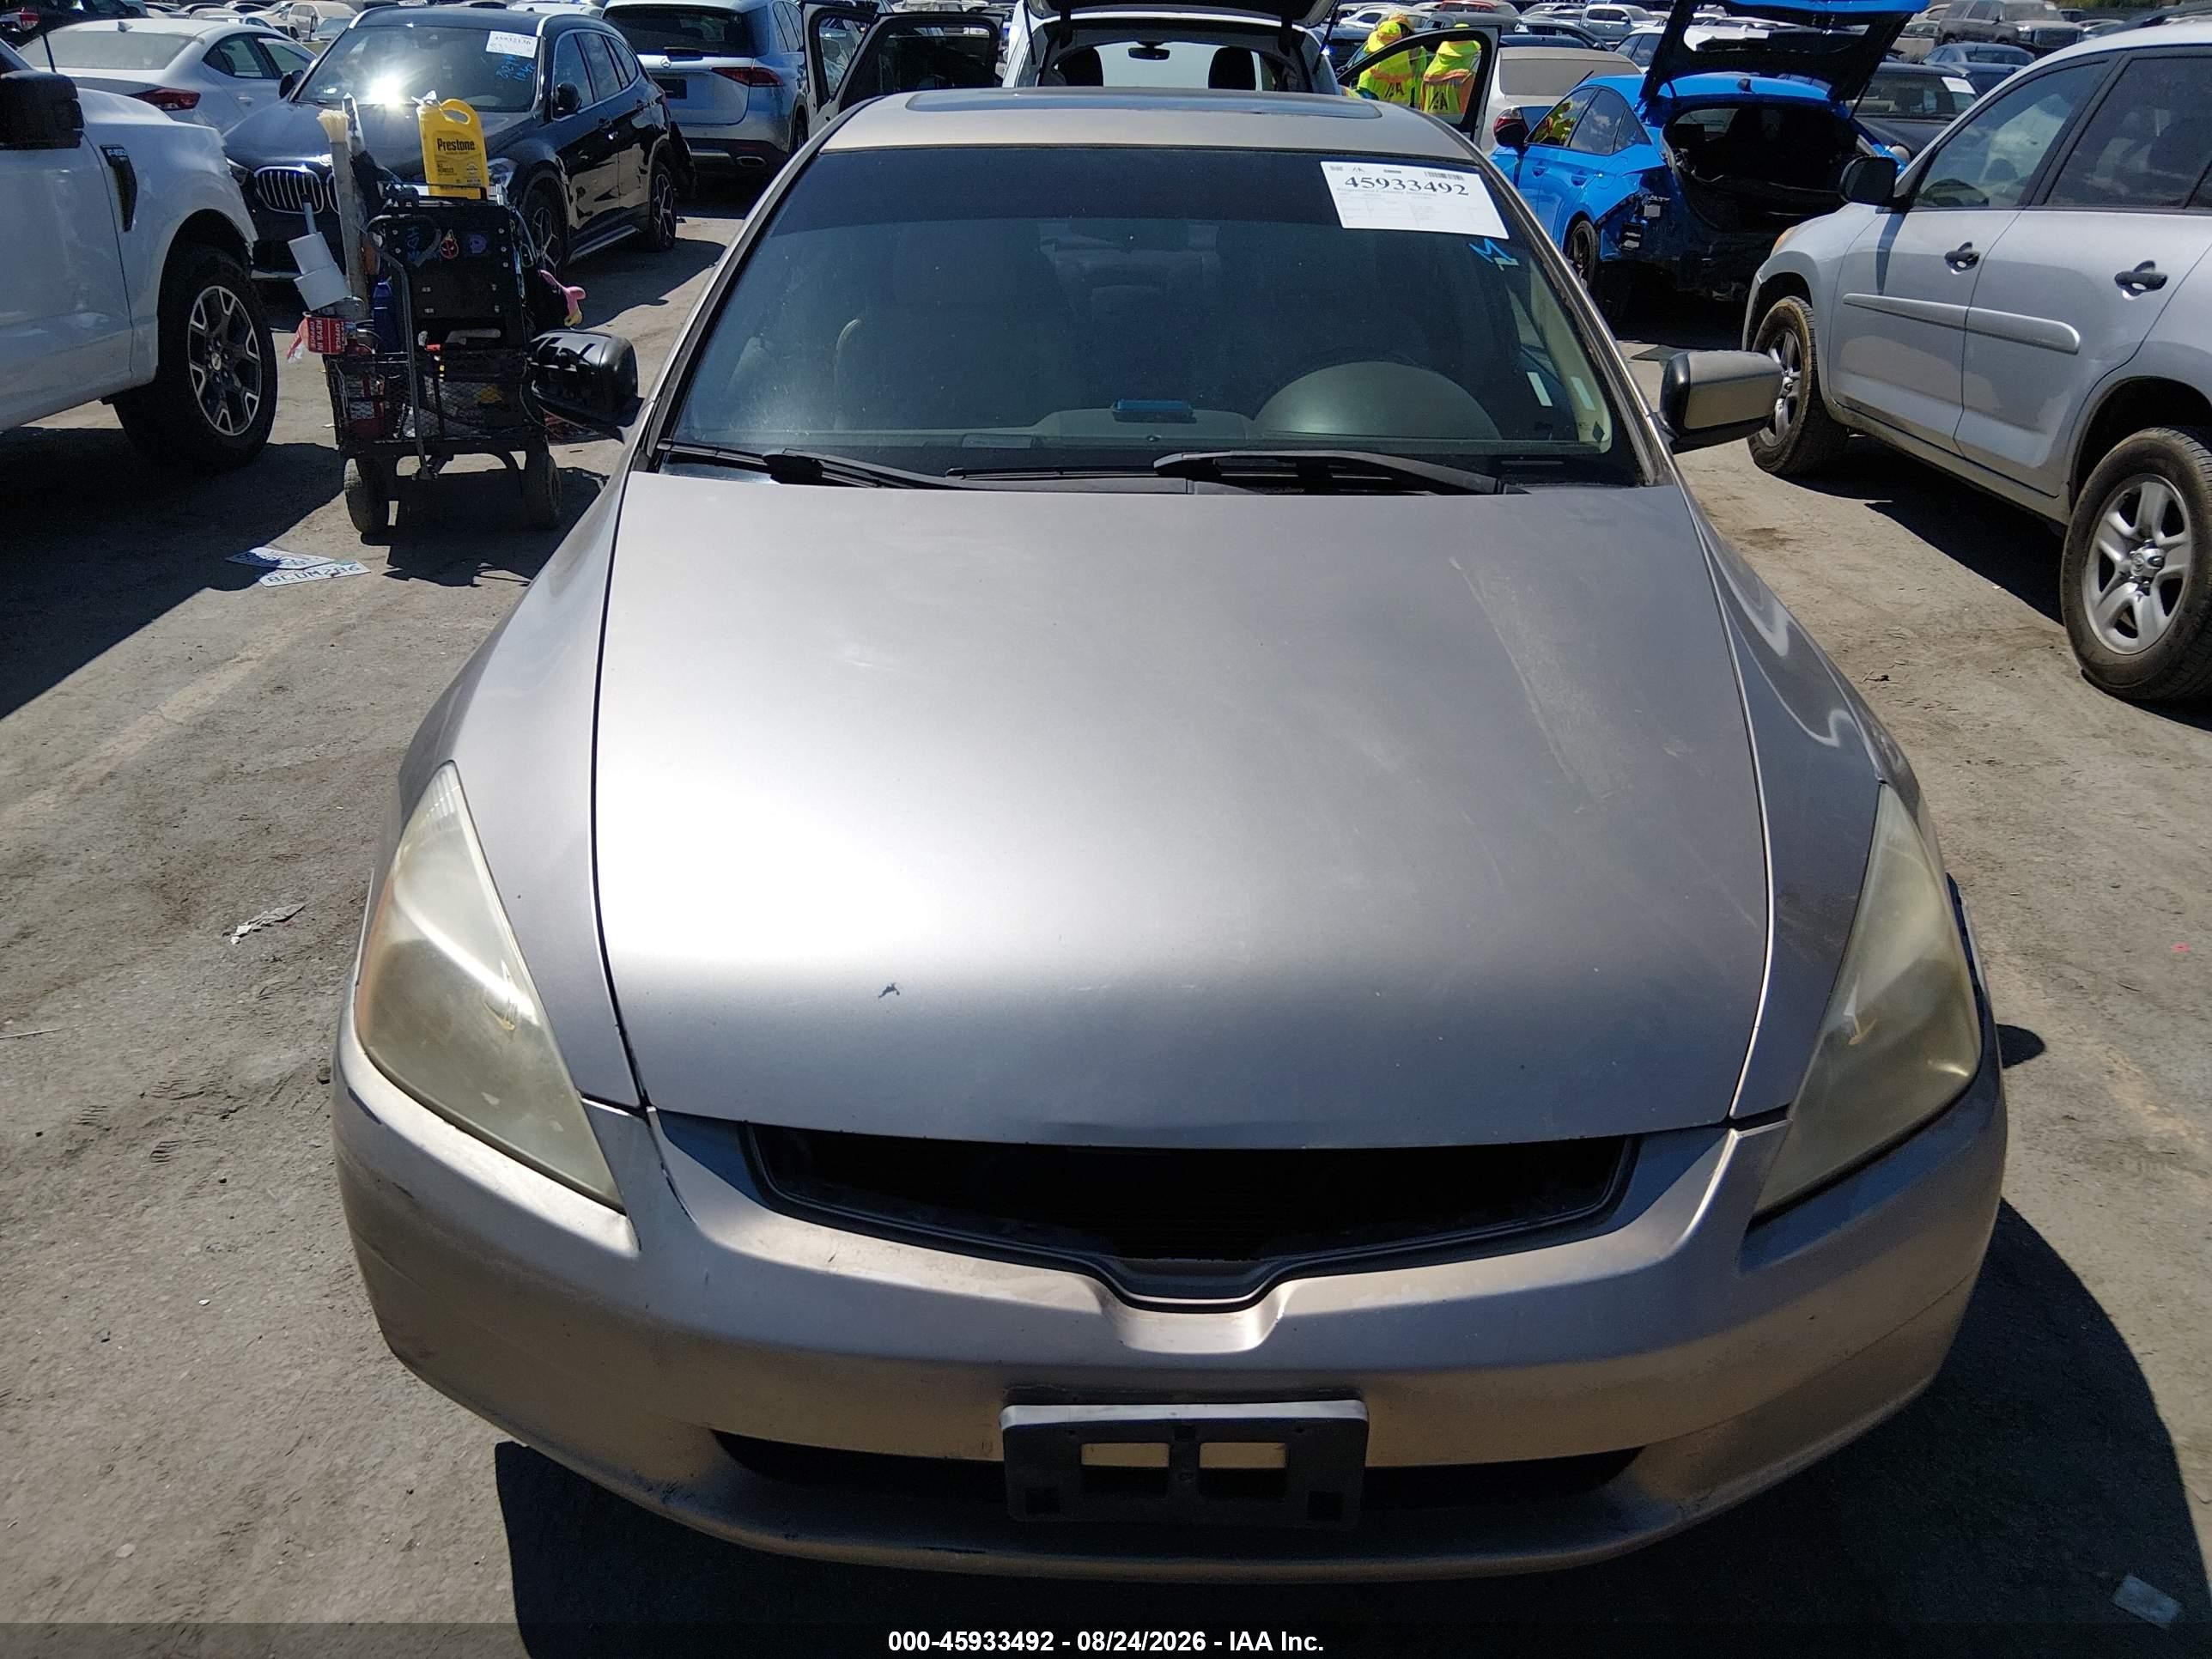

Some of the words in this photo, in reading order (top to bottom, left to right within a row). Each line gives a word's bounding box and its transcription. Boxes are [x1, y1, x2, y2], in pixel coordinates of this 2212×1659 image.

[436, 137, 476, 152] Prestone
[1345, 175, 1469, 197] 45933492
[315, 319, 324, 340] KEYS
[316, 342, 324, 351] IN
